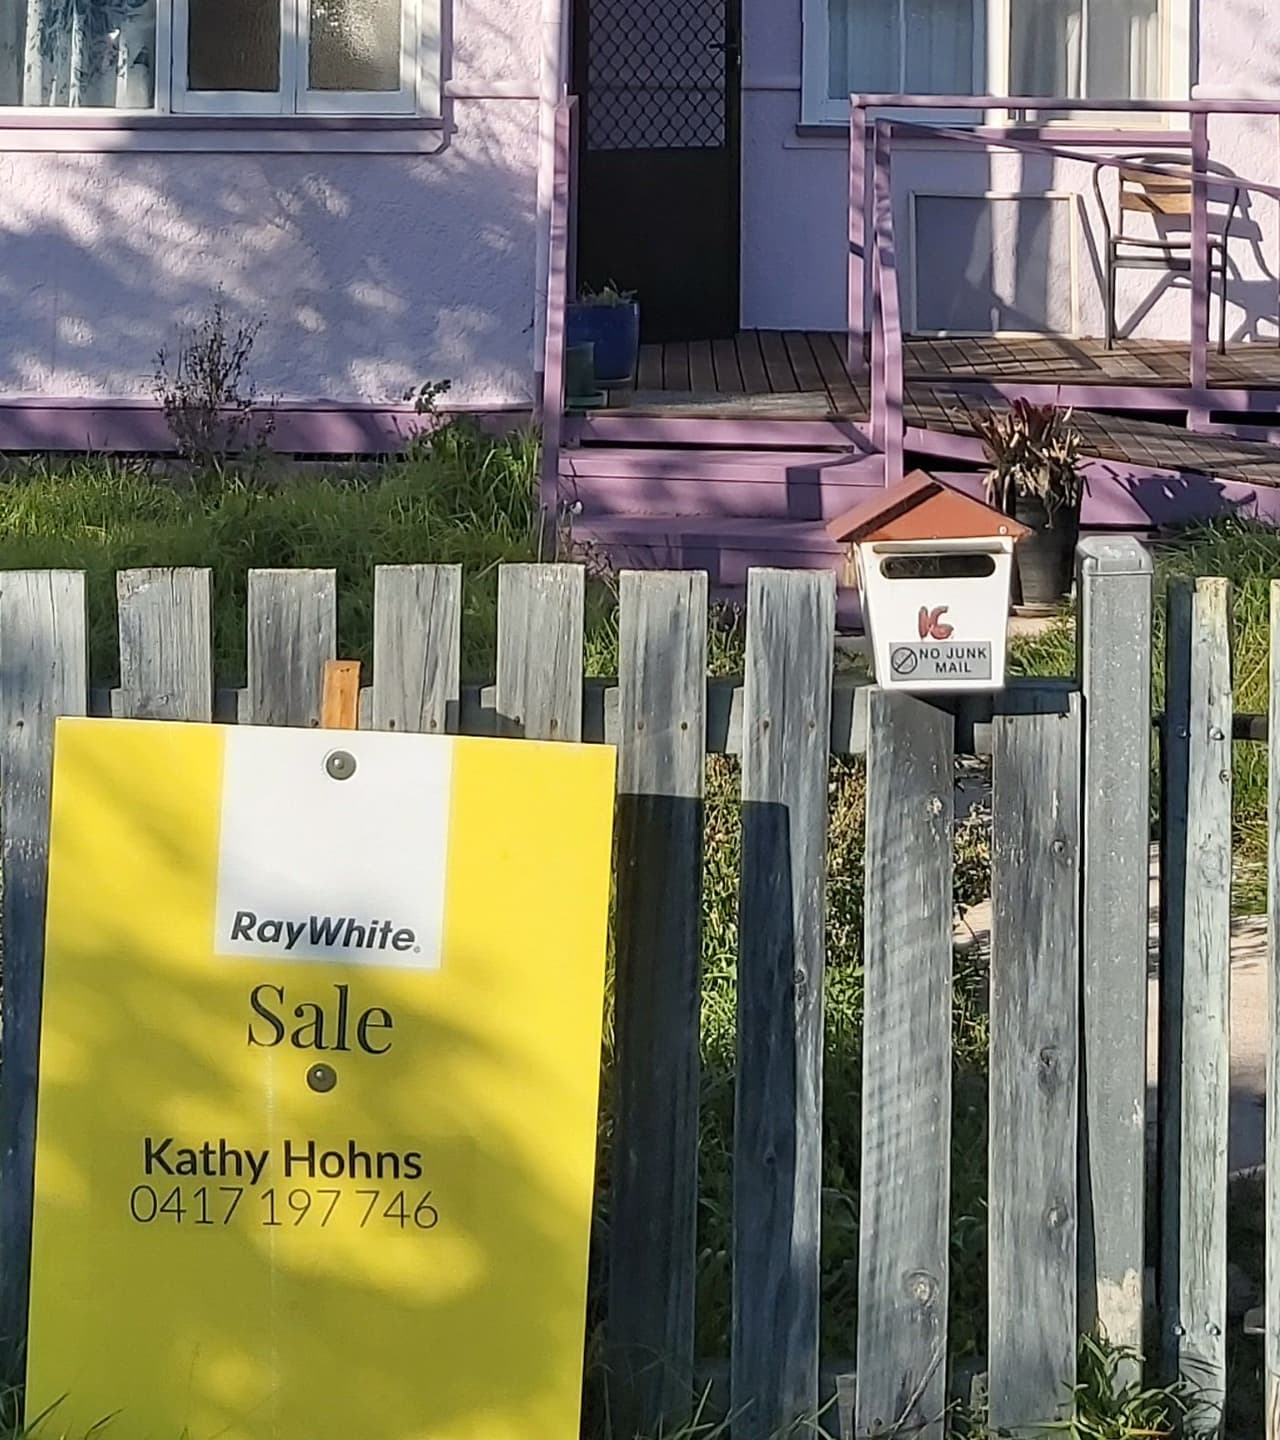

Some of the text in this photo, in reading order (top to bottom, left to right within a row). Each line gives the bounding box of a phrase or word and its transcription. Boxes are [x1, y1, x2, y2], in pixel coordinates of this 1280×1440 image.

[919, 647, 987, 660] NO JUNK
[935, 661, 972, 673] MAIL
[247, 983, 394, 1055] Sale
[143, 1136, 423, 1186] Kathy Hohns
[129, 1184, 439, 1230] 0417 197 746
